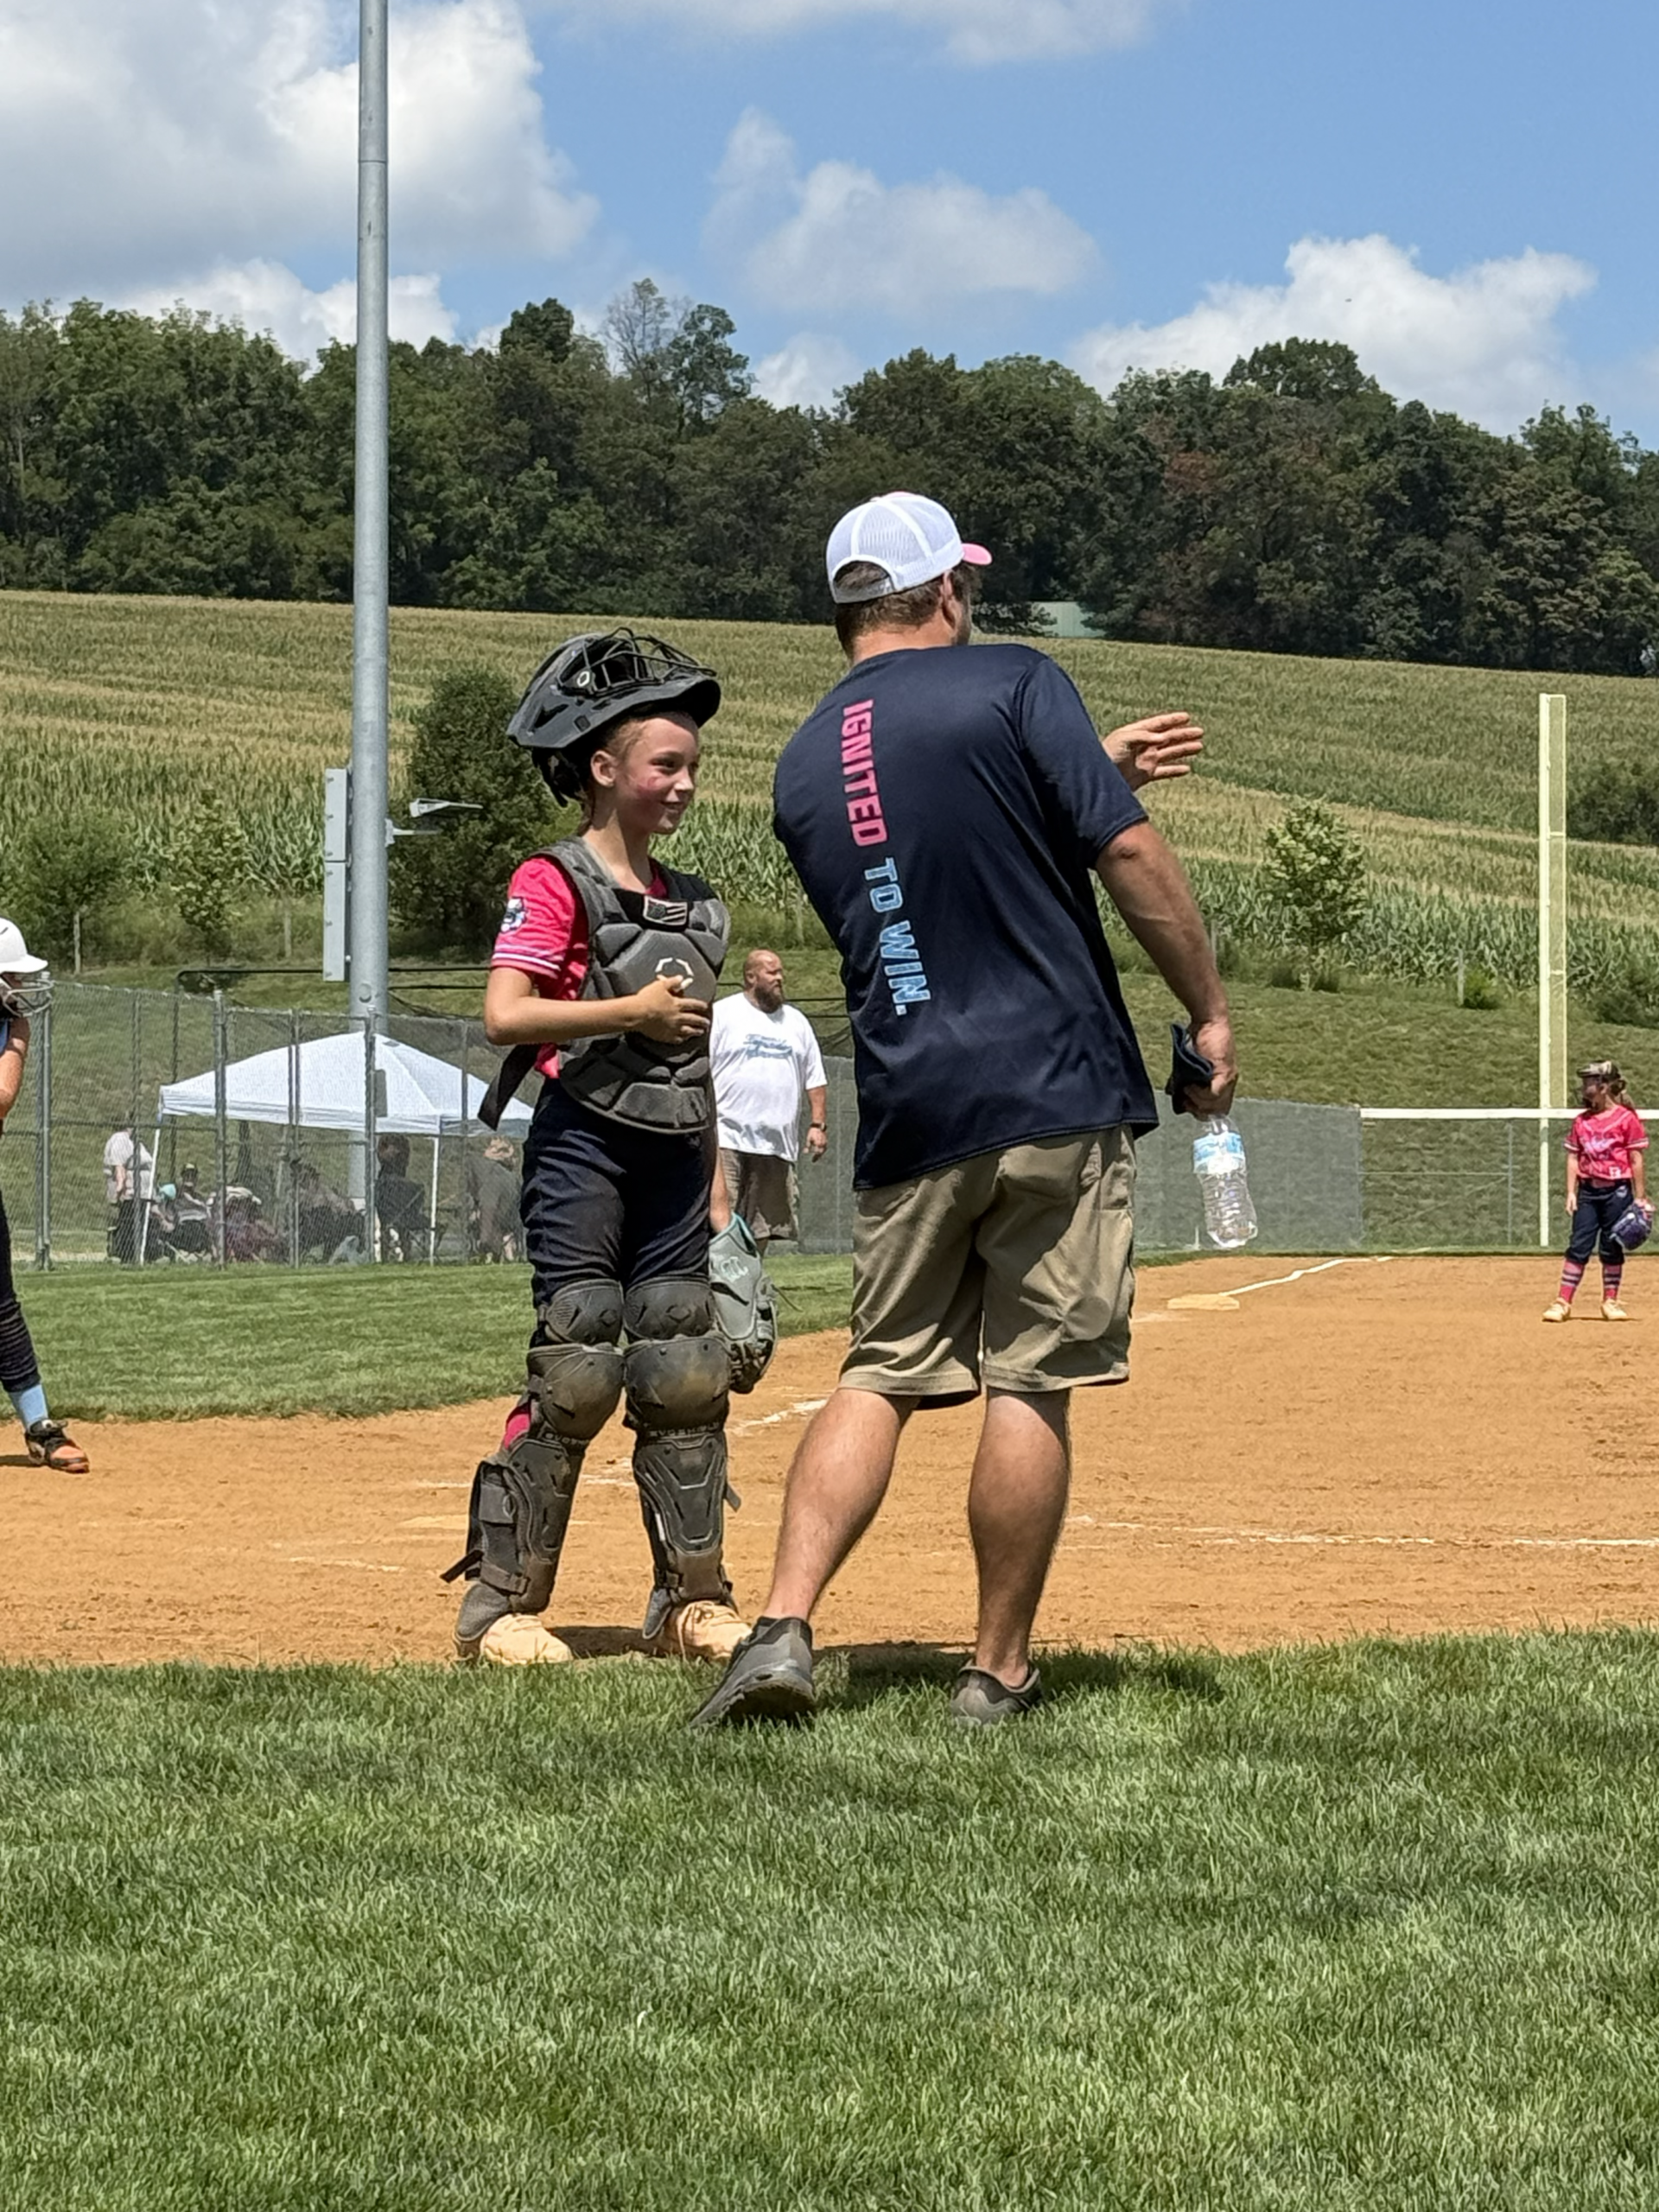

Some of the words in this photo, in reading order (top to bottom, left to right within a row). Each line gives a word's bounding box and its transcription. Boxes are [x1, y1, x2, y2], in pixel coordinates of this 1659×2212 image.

[842, 699, 887, 847] IGNITED
[865, 857, 903, 912] TO
[880, 920, 931, 1016] WIN.
